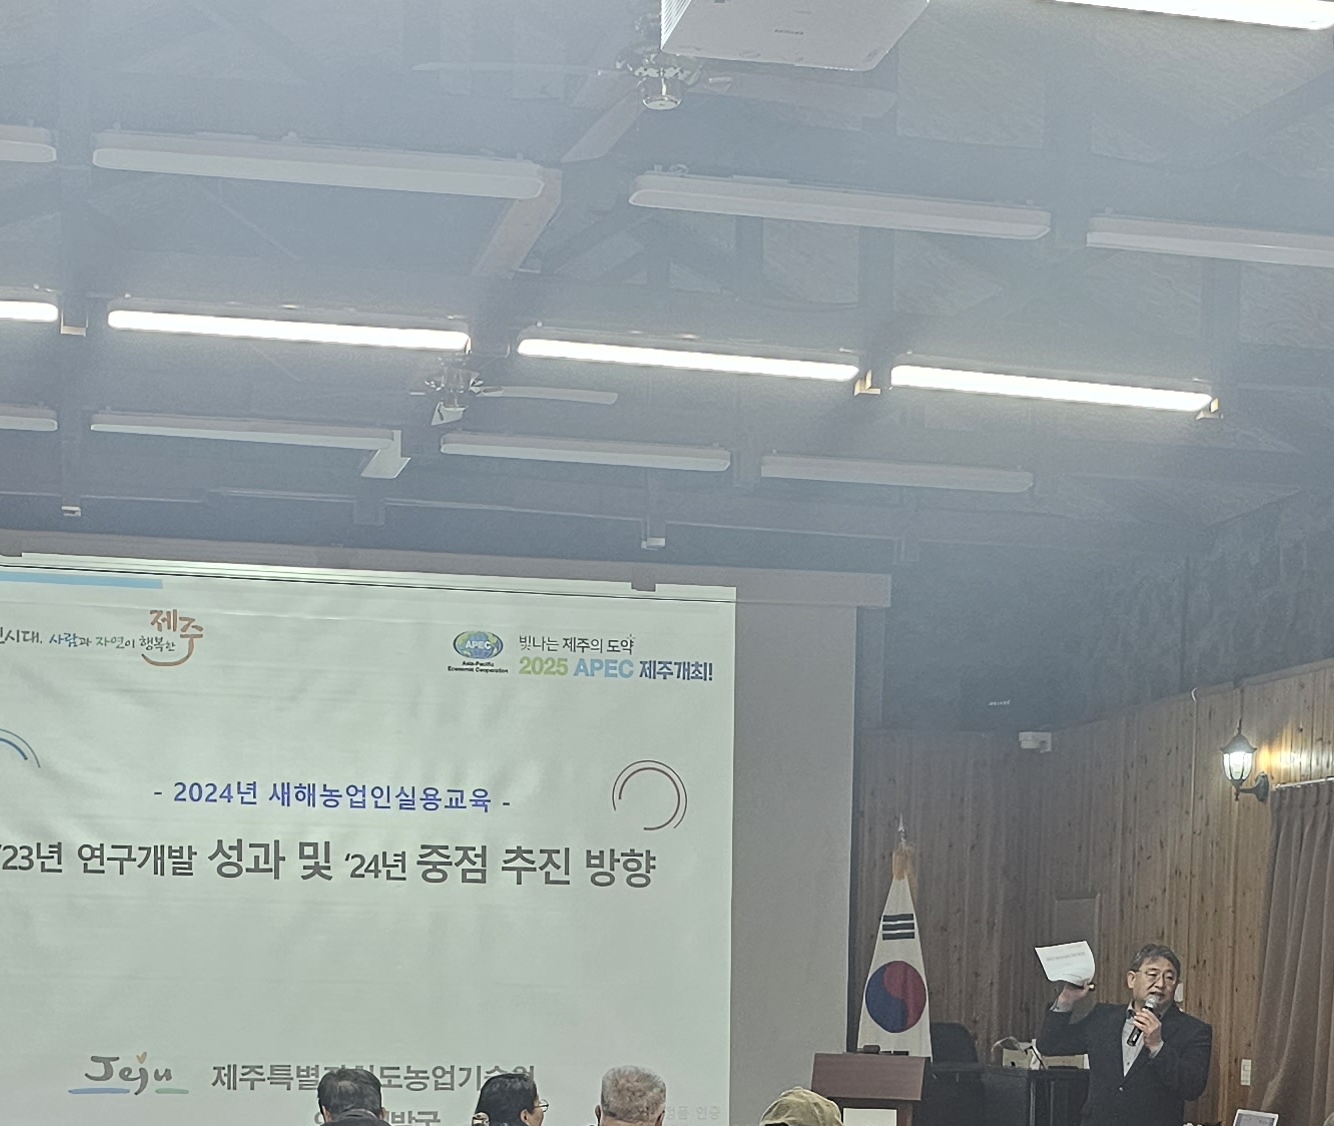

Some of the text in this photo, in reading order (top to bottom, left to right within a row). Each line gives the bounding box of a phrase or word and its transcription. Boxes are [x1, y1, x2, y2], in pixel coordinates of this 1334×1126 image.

[49, 632, 92, 648] 사람과
[95, 636, 135, 650] 자연이
[139, 635, 176, 652] 행복한
[142, 608, 204, 666] 제주
[465, 641, 492, 650] APEC
[519, 635, 634, 655] 빛나는 제주의 도약
[519, 656, 713, 682] 2025 APEC 제주개최!
[173, 781, 491, 813] 2024년 새해농업인실용교육
[77, 843, 197, 876] 연구개발
[208, 838, 286, 880] 성과
[298, 840, 333, 880] 및
[416, 843, 487, 884] 중점
[501, 845, 571, 886] 추진
[585, 847, 657, 889] 방향
[84, 1052, 174, 1096] Jeju
